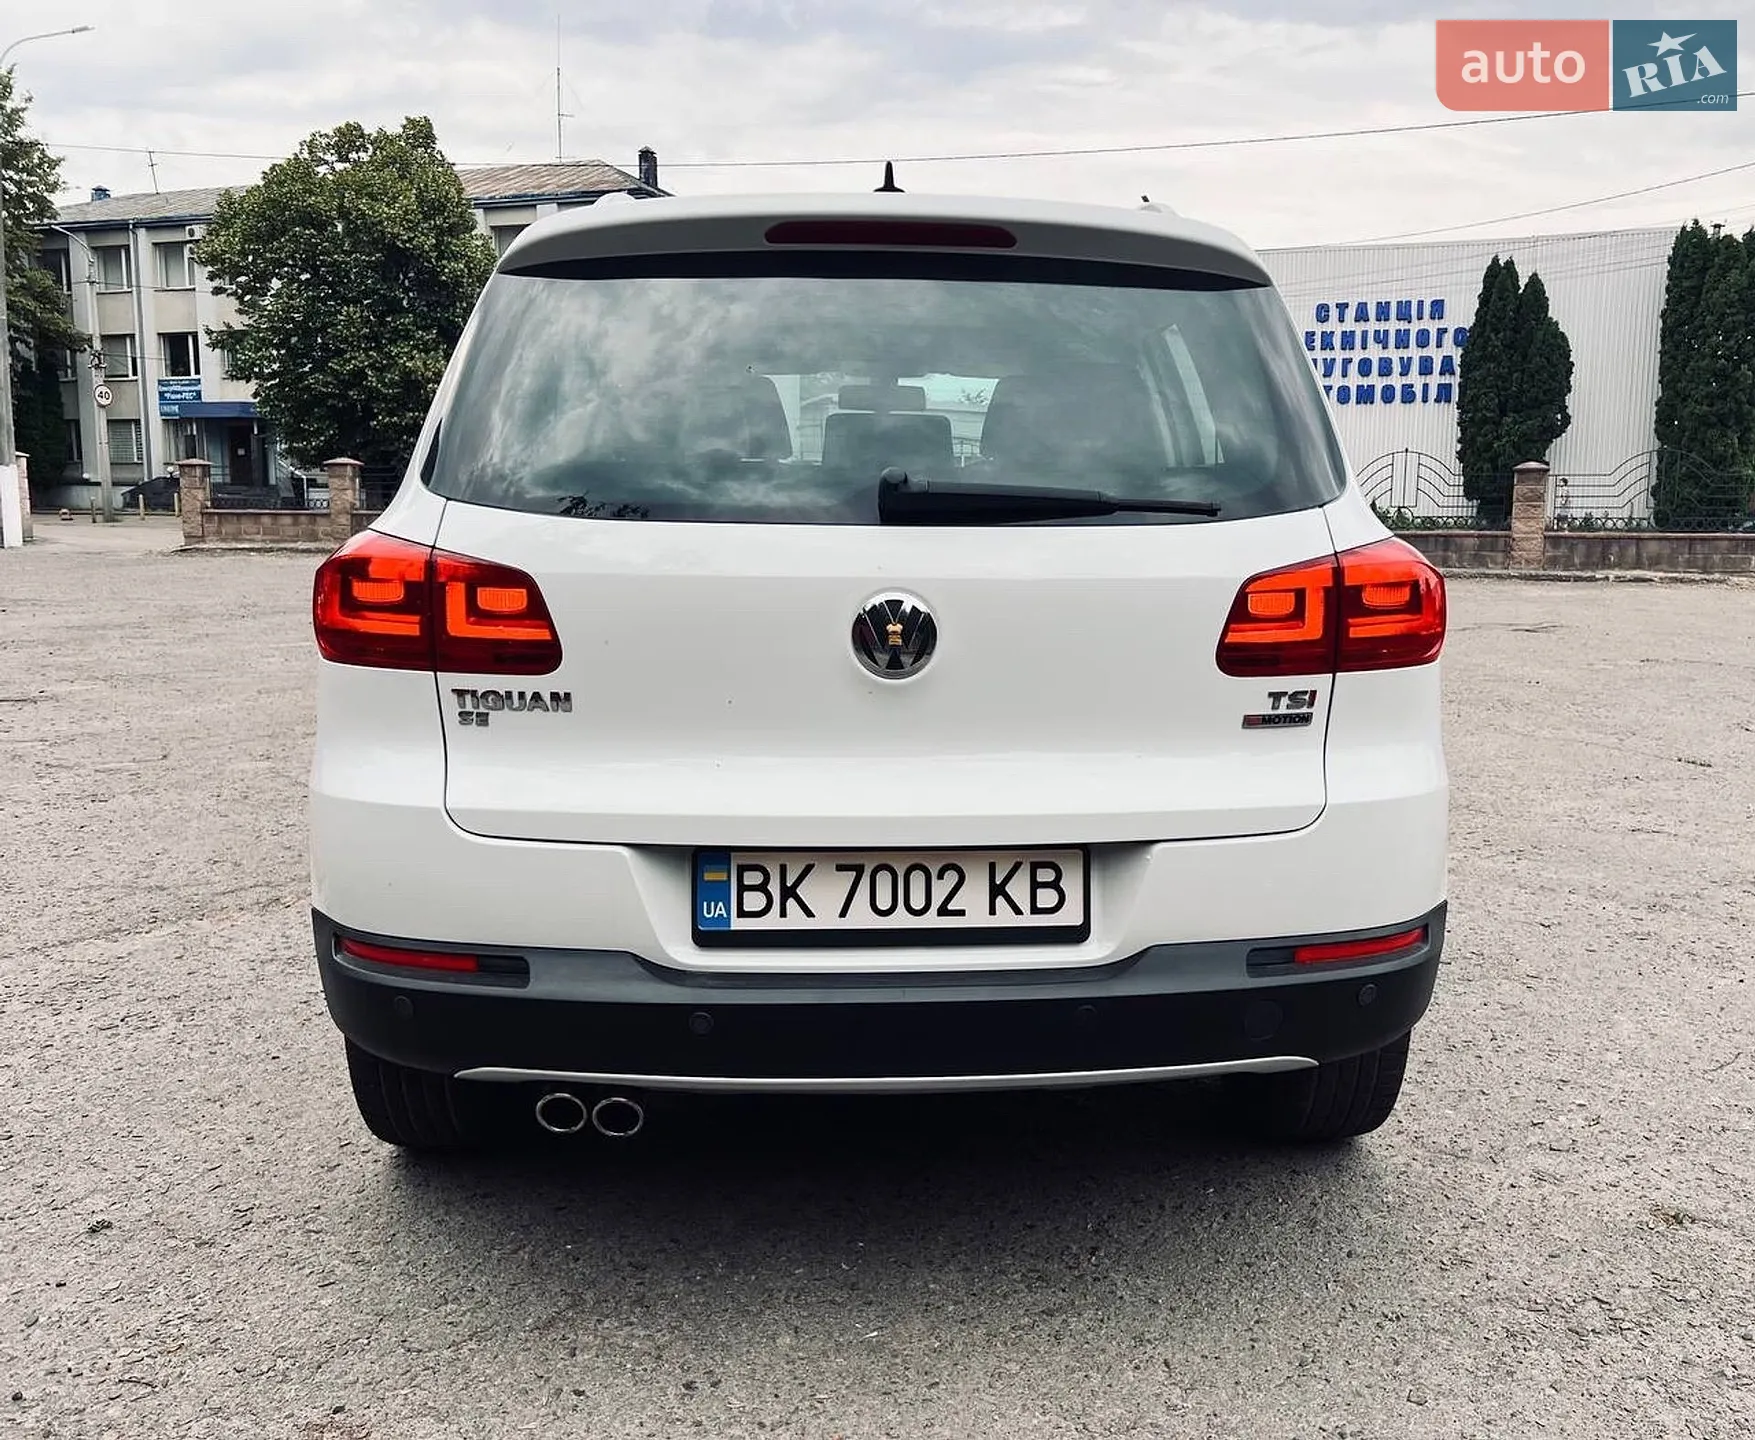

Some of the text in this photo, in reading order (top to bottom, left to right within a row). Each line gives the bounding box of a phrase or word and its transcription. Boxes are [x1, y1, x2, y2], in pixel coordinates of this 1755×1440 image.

[1315, 299, 1445, 323] СТАНЦІЯ
[97, 391, 110, 400] 40
[450, 688, 573, 713] TIGUAN
[1267, 689, 1318, 711] TSI
[457, 710, 489, 727] SE
[736, 861, 1066, 919] BK 7002 KB
[702, 901, 727, 918] UA
